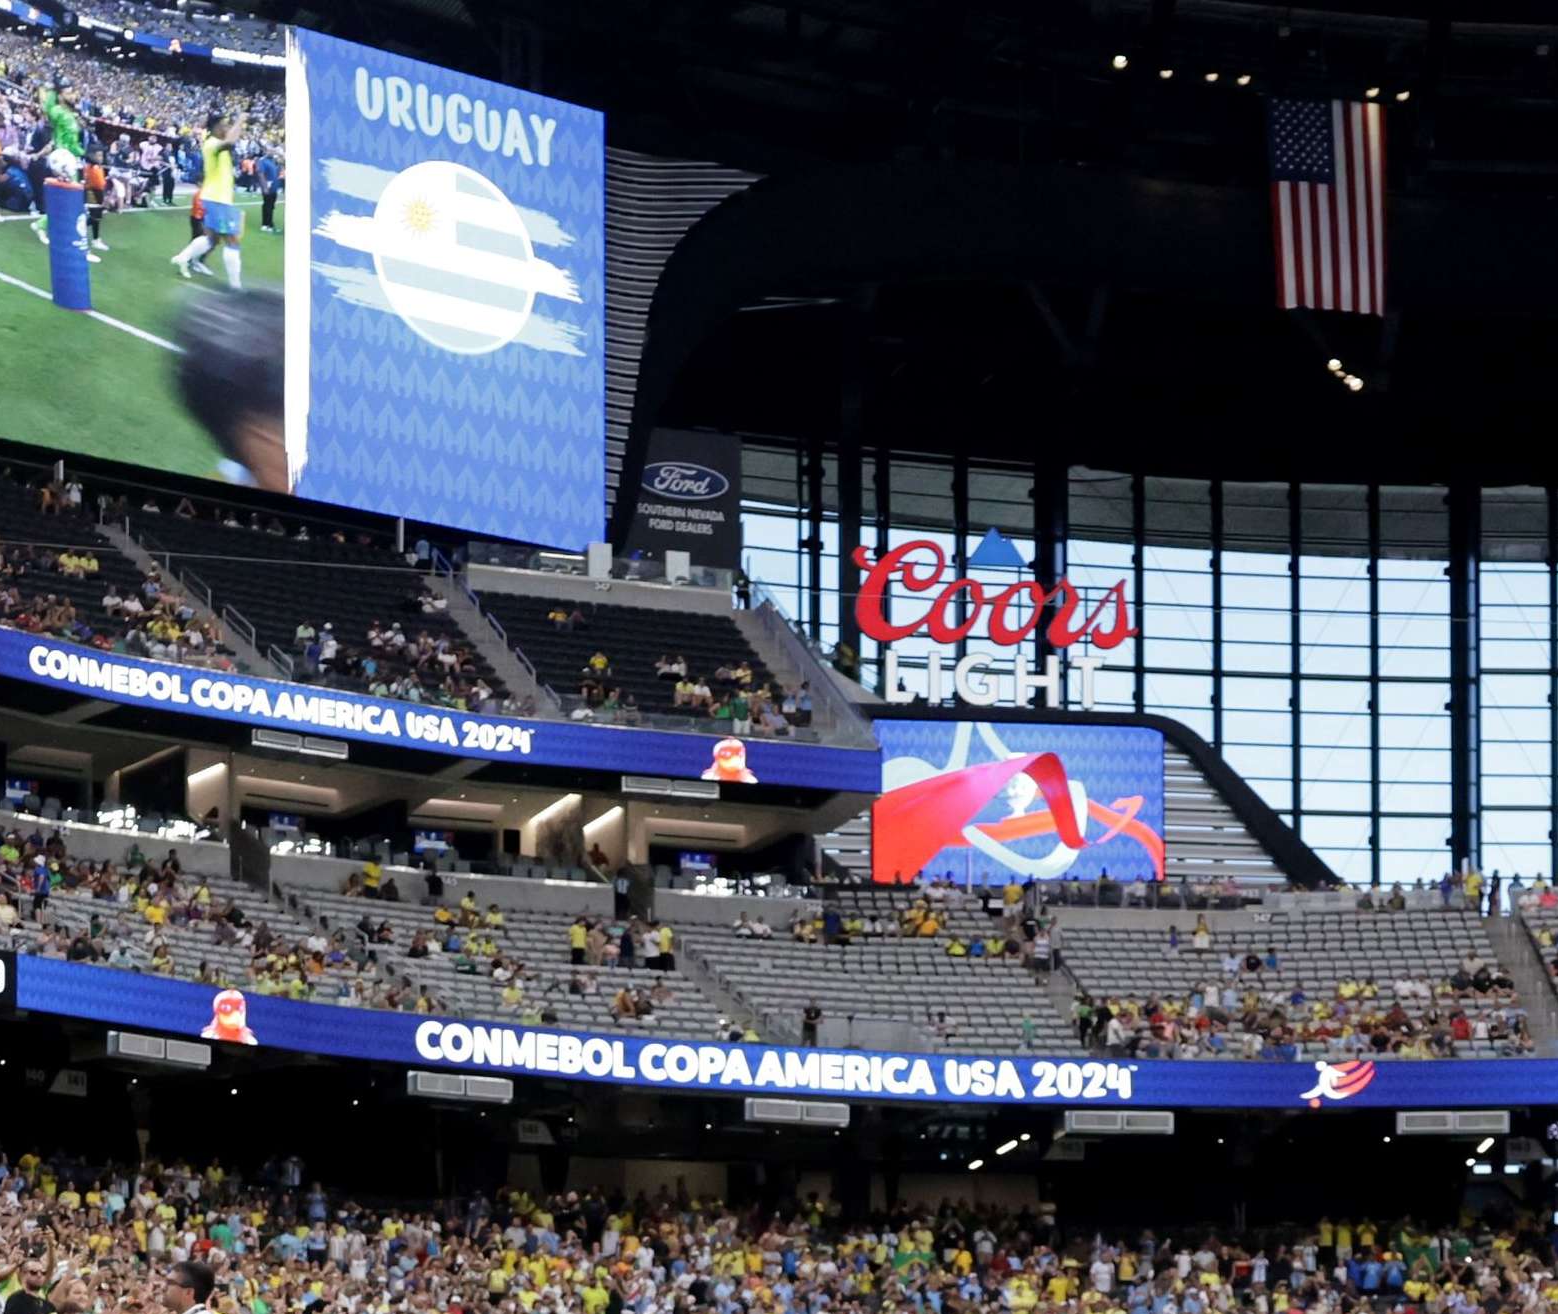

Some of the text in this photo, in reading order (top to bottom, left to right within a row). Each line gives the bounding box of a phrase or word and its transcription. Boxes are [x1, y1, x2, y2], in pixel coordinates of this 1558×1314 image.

[355, 67, 557, 166] URUGUAY
[653, 464, 710, 496] Ford
[687, 507, 725, 522] NEVADA
[649, 518, 713, 535] FORD DEALERS
[852, 539, 1139, 649] Coors
[29, 645, 532, 754] CONMEBOL COPA AMERICA USA 2024
[884, 649, 1106, 711] LIGHT
[415, 1020, 1133, 1100] CONMEBOL COPA AMERICA USA 2024
